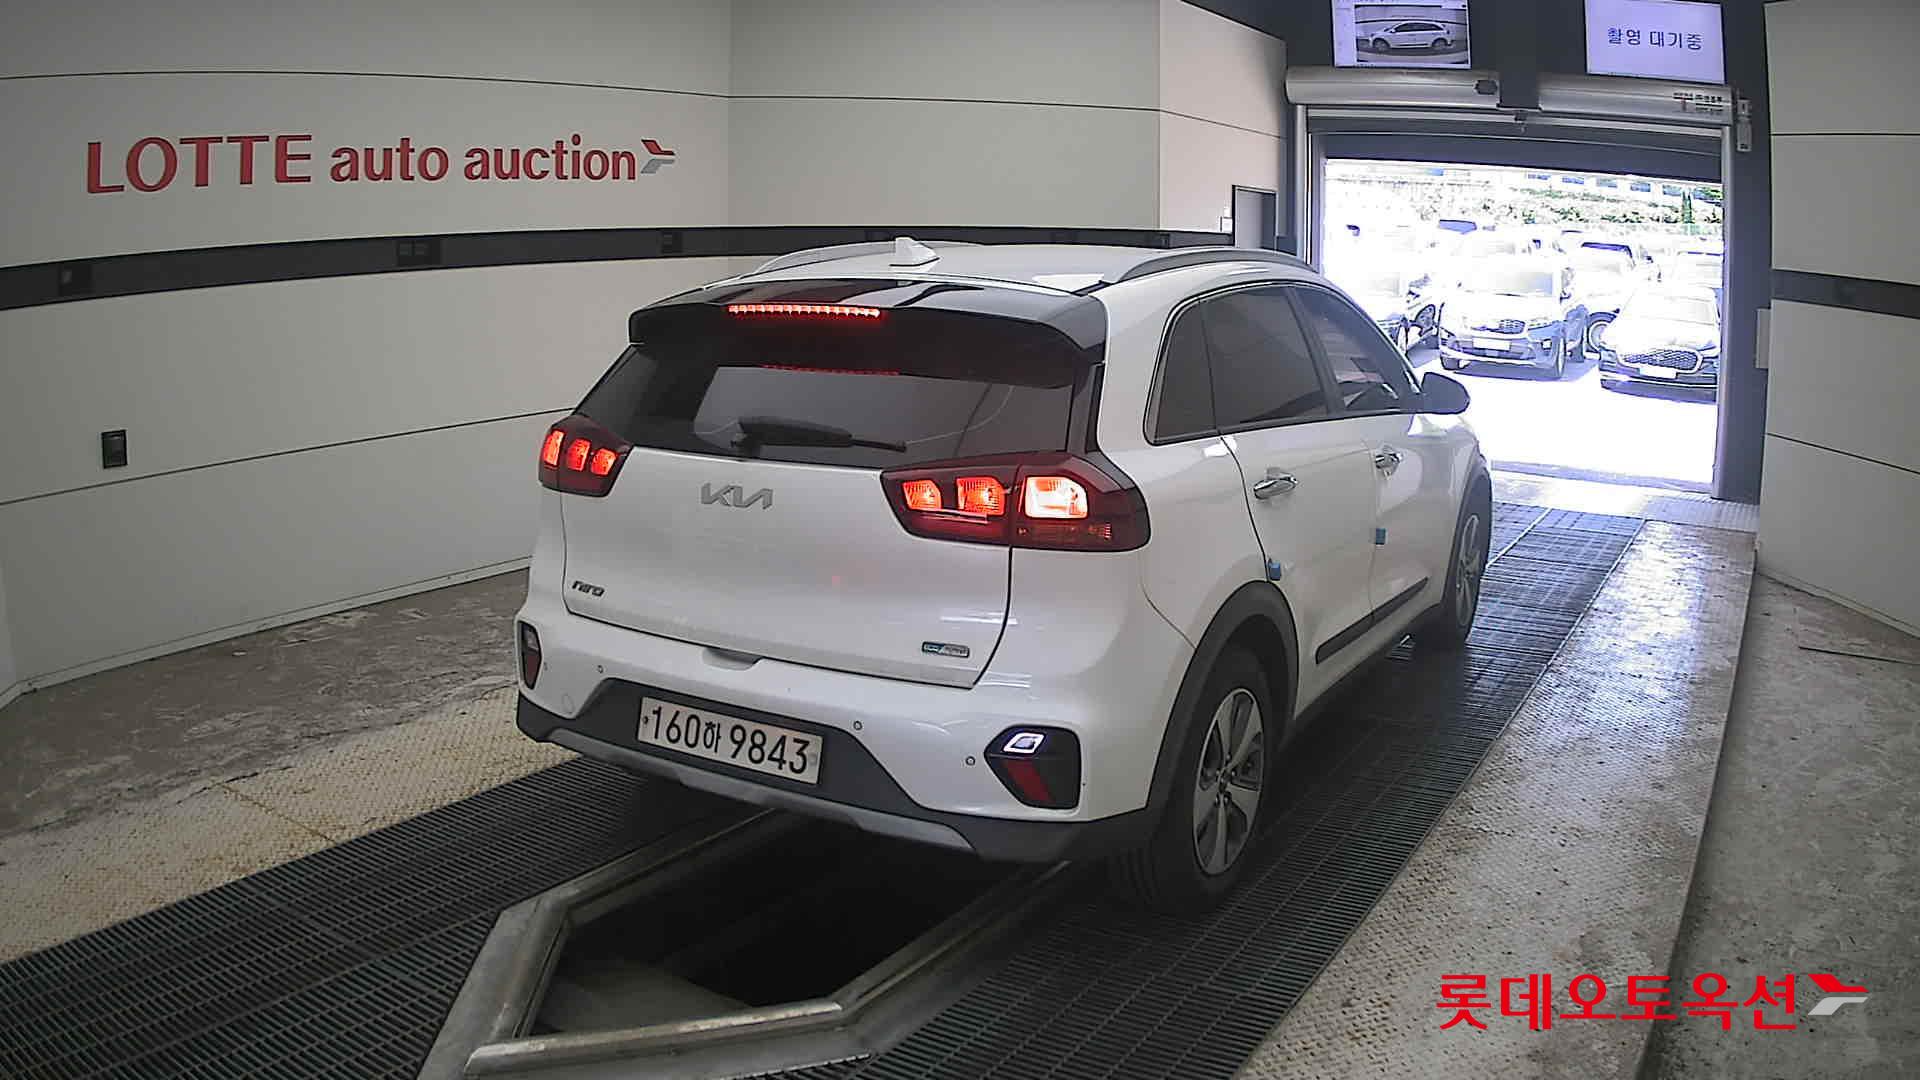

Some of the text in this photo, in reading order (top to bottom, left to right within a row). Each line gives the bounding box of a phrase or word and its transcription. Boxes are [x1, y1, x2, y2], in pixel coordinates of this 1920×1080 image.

[1607, 28, 1702, 51] 촬영 대기중
[87, 133, 637, 194] LOTTE auto auction
[701, 482, 773, 510] KIA
[652, 705, 810, 774] 160하 9843
